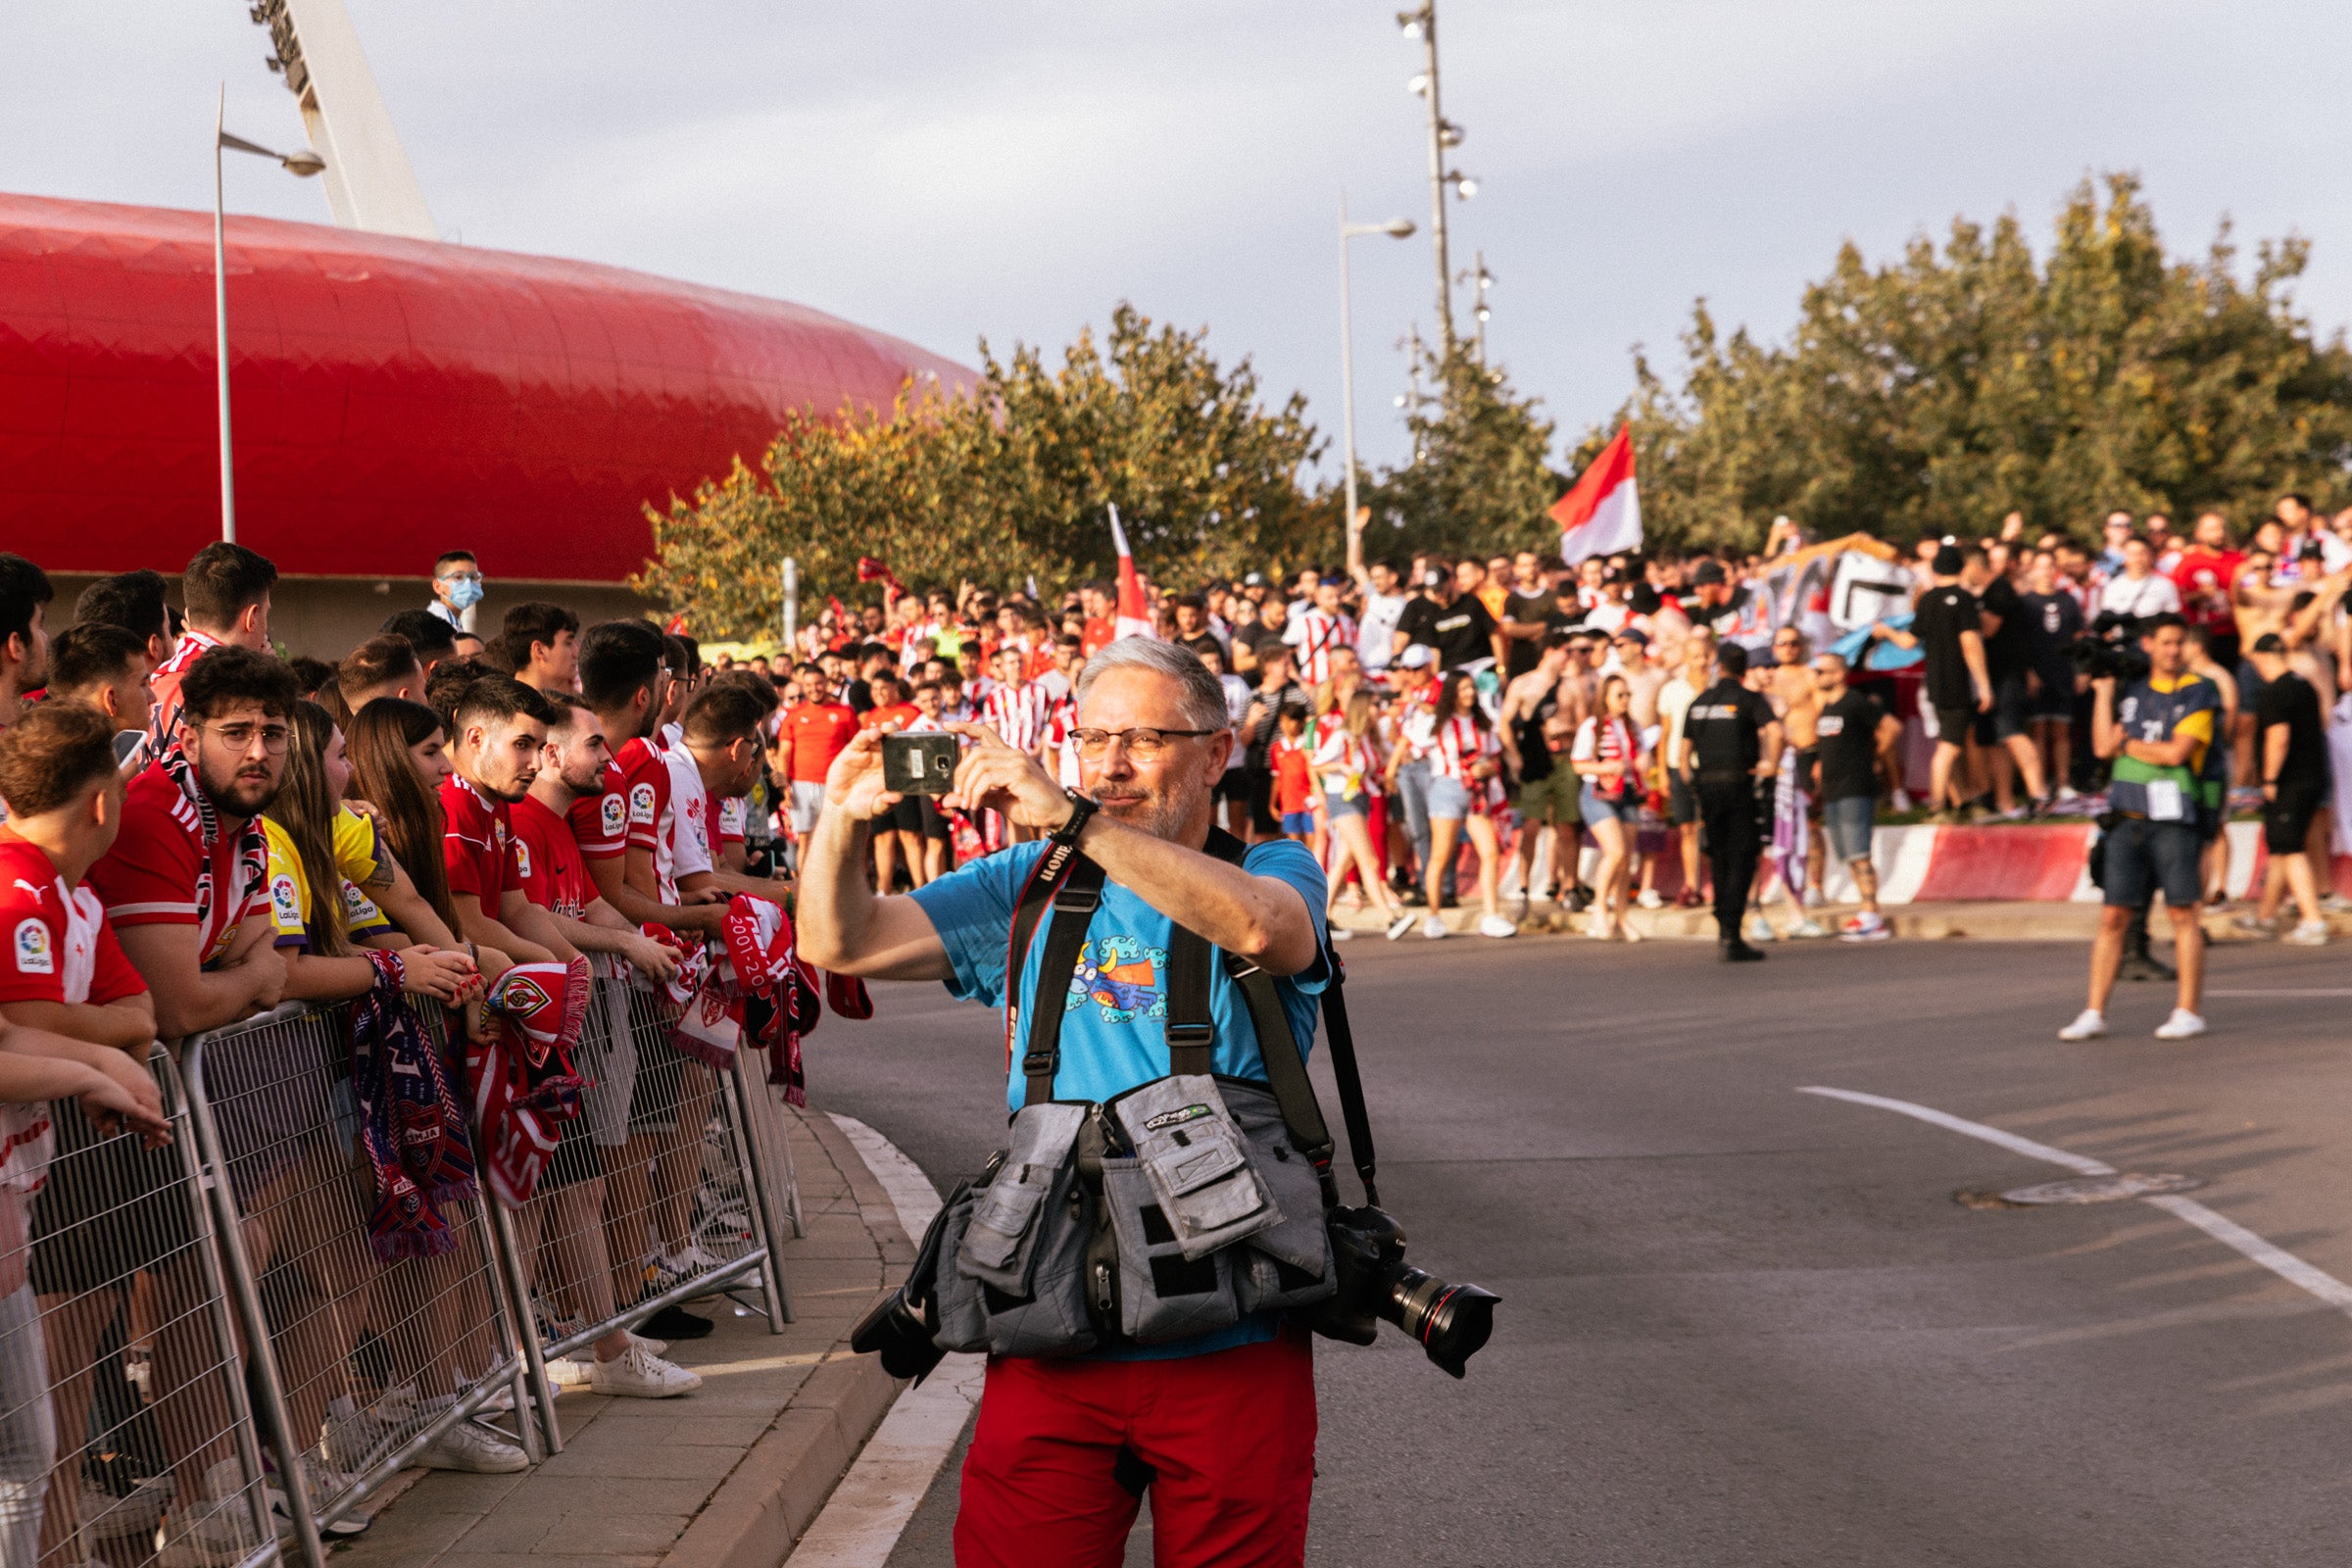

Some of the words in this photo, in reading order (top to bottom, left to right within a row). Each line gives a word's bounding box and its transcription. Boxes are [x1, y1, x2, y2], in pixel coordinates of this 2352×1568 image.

[632, 810, 653, 819] LaLiga
[605, 822, 623, 832] LaLiga
[1040, 843, 1074, 882] anon
[279, 910, 300, 920] LaLiga
[350, 906, 373, 918] aLiga
